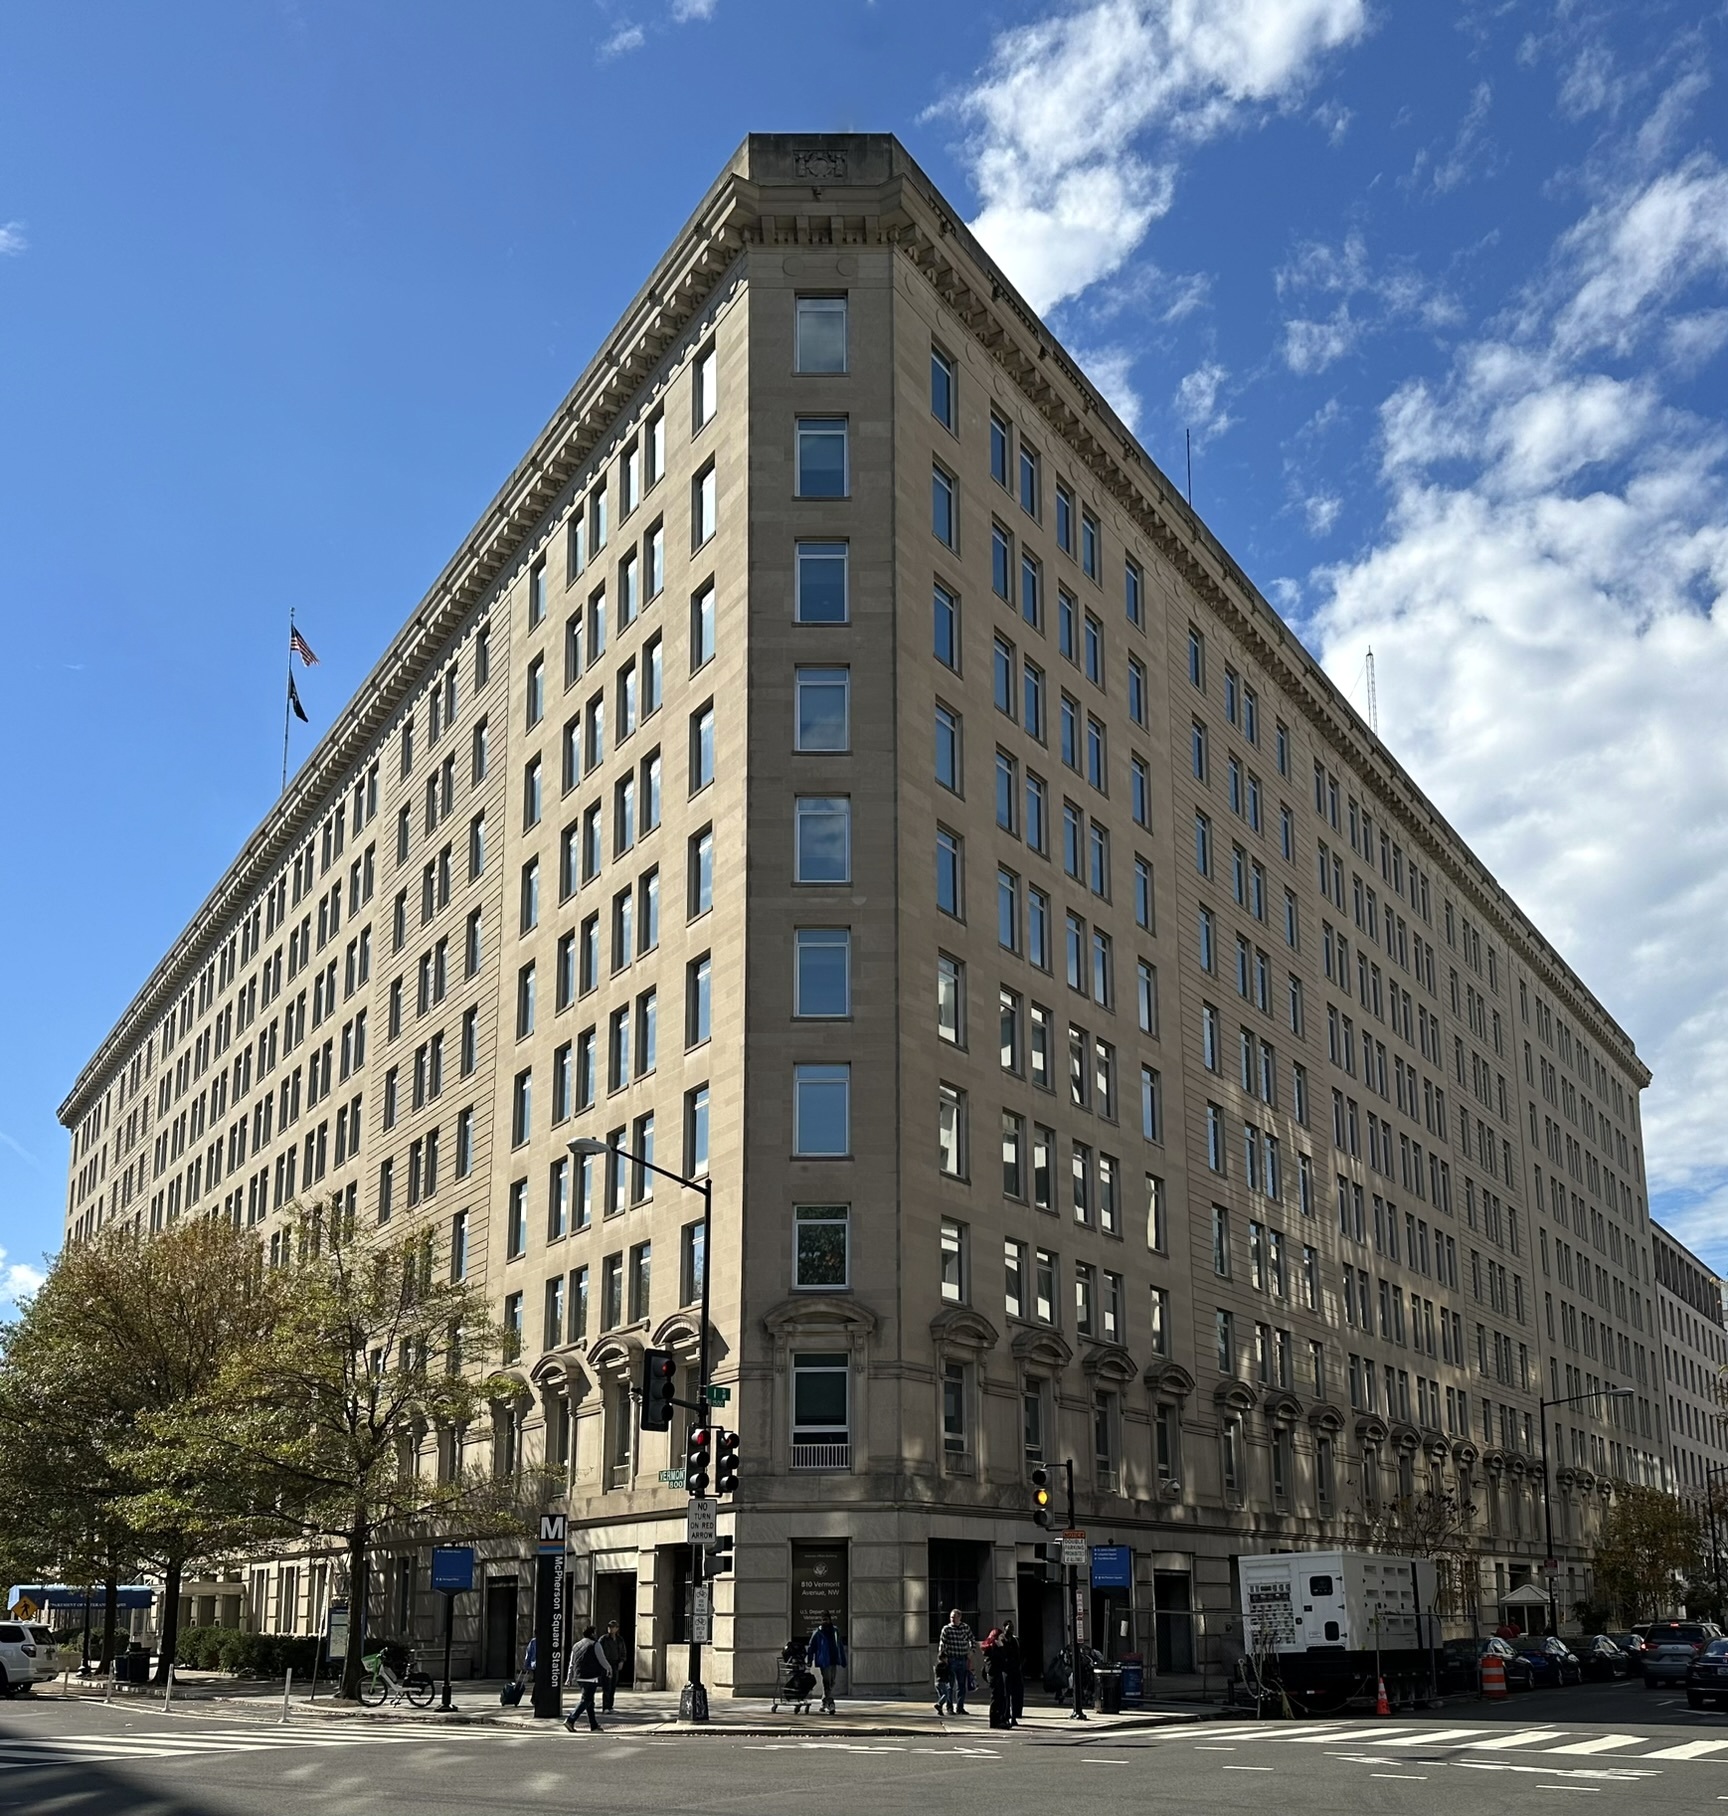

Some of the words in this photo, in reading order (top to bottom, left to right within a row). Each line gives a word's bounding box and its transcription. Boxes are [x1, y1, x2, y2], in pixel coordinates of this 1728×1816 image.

[669, 1480, 683, 1489] 800
[694, 1512, 711, 1520] TURN
[697, 1502, 708, 1511] NO
[540, 1516, 564, 1540] M
[553, 1556, 563, 1610] McPherson
[551, 1613, 562, 1648] Square
[551, 1651, 561, 1688] Station
